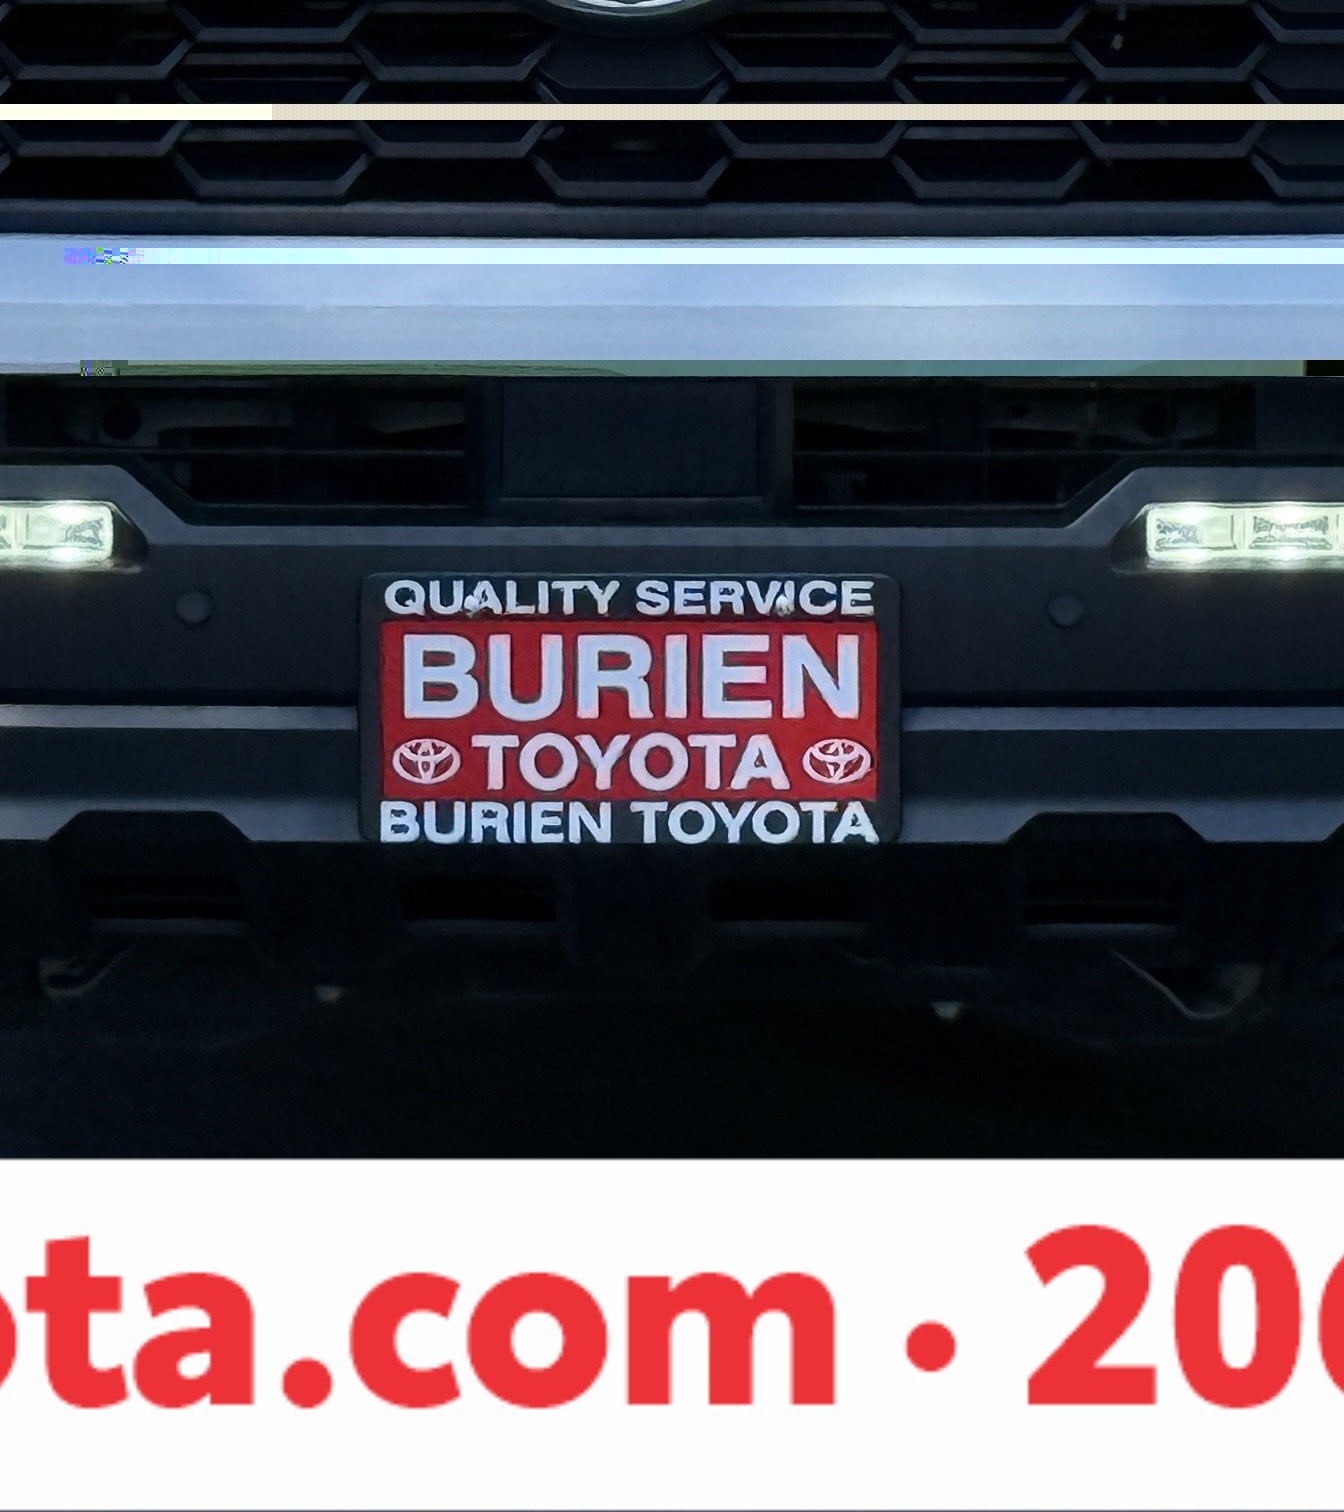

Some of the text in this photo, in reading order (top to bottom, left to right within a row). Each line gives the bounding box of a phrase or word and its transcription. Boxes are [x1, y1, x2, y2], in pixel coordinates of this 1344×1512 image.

[384, 579, 875, 616] QUALITY SERVICE
[402, 633, 860, 722] BURIEN
[471, 732, 791, 792] TOYOTA
[379, 800, 880, 844] BURIEN TOYOTA
